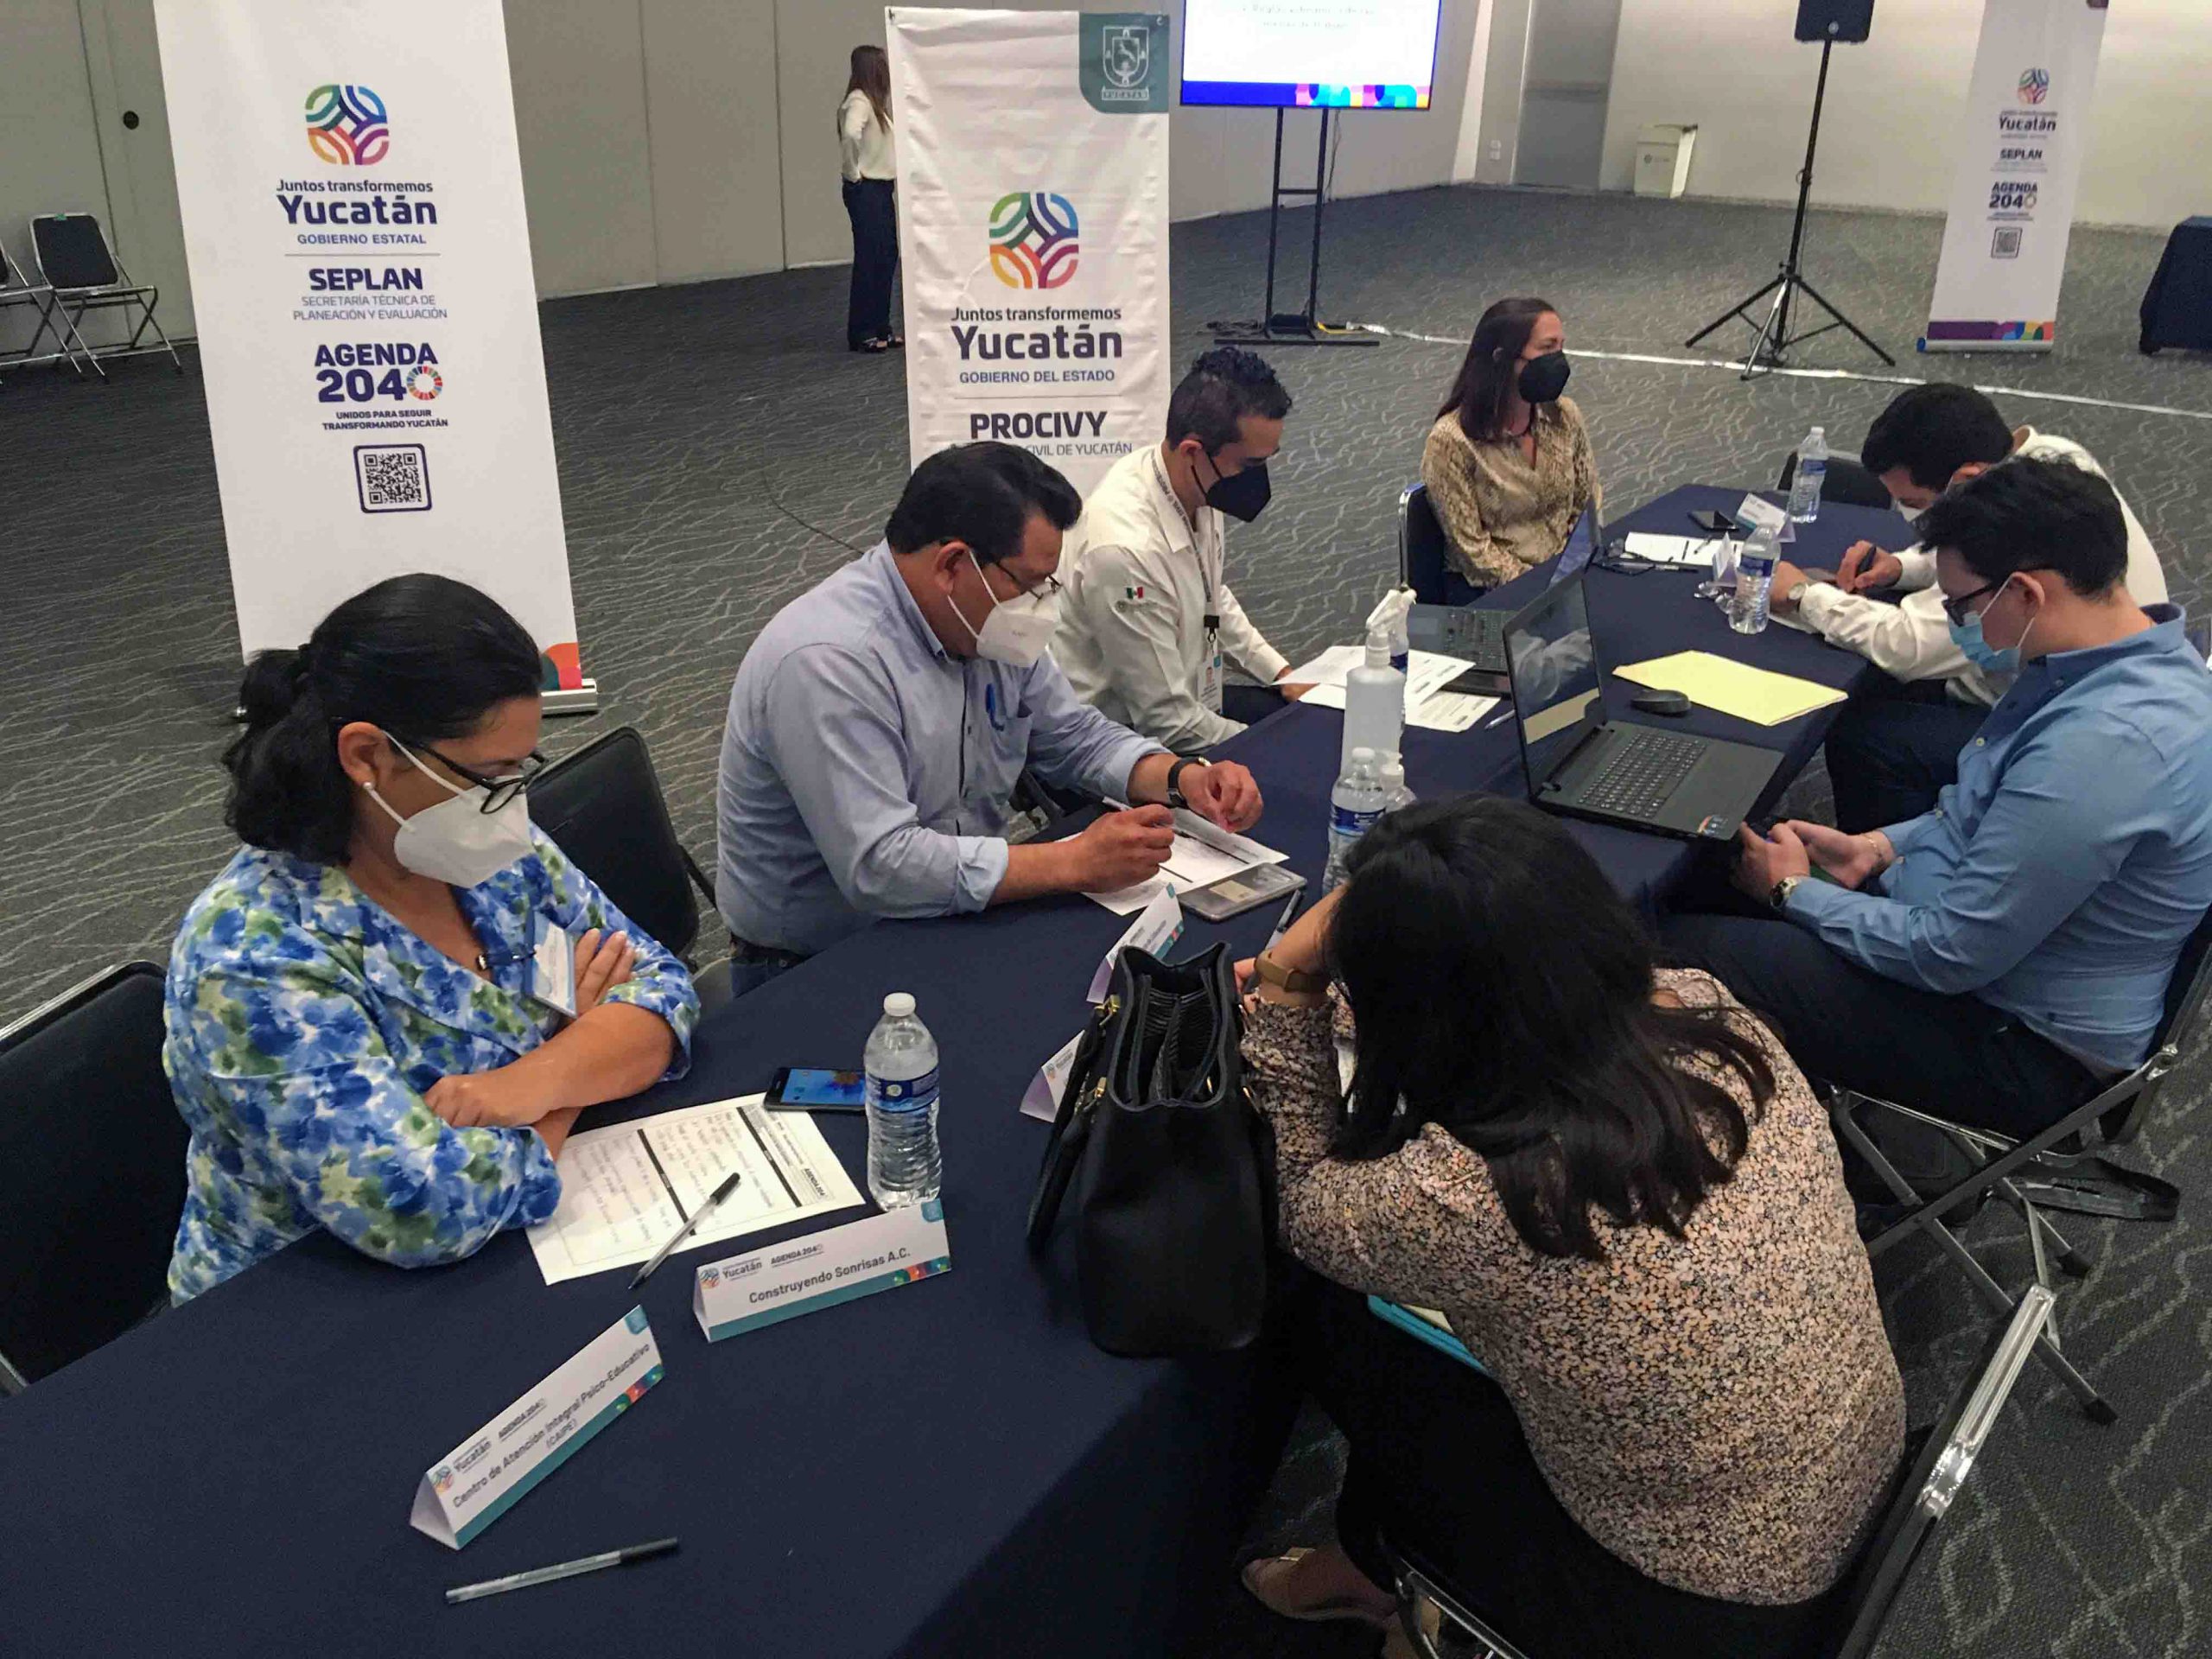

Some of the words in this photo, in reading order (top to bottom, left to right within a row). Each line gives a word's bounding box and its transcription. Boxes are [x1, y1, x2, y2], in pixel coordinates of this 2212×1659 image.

[1999, 149, 2043, 160] SEPLAN
[276, 179, 325, 192] Juntos
[327, 180, 434, 192] transformemos
[276, 194, 438, 225] Yucatán
[297, 234, 368, 245] GOBIERNO
[372, 233, 427, 245] ESTATAL
[308, 268, 423, 291] SEPLAN
[301, 295, 371, 307] SECRETARÍA
[372, 294, 419, 306] TÉCNICA
[421, 295, 436, 305] DE
[293, 308, 365, 321] PLANEACIÓN
[369, 310, 377, 320] Y
[378, 308, 448, 320] EVALUACIÓN
[951, 307, 1003, 321] Juntos
[1006, 307, 1122, 321] transformemos
[951, 323, 1122, 360] Yucatán
[315, 342, 439, 366] AGENDA
[959, 372, 1030, 384] GOBIERNO
[1033, 371, 1059, 383] DEL
[1063, 369, 1115, 382] ESTADO
[336, 410, 372, 420] UNIDOS
[372, 410, 397, 419] PARA
[398, 409, 432, 418] SEGUIR
[321, 420, 406, 431] TRANSFORMANDO
[406, 418, 448, 429] YUCATÁN
[969, 410, 1108, 440] PROCIVY
[1057, 443, 1073, 455] DE
[1075, 442, 1132, 455] YUCATÁN
[721, 1261, 762, 1281] Yucatán
[749, 1271, 832, 1304] Construyendo
[835, 1255, 886, 1278] Sonrisas
[887, 1247, 911, 1262] A.C.
[453, 1478, 488, 1508] Centro
[488, 1465, 502, 1481] de
[503, 1429, 544, 1468] Atención
[544, 1402, 581, 1433] Integral
